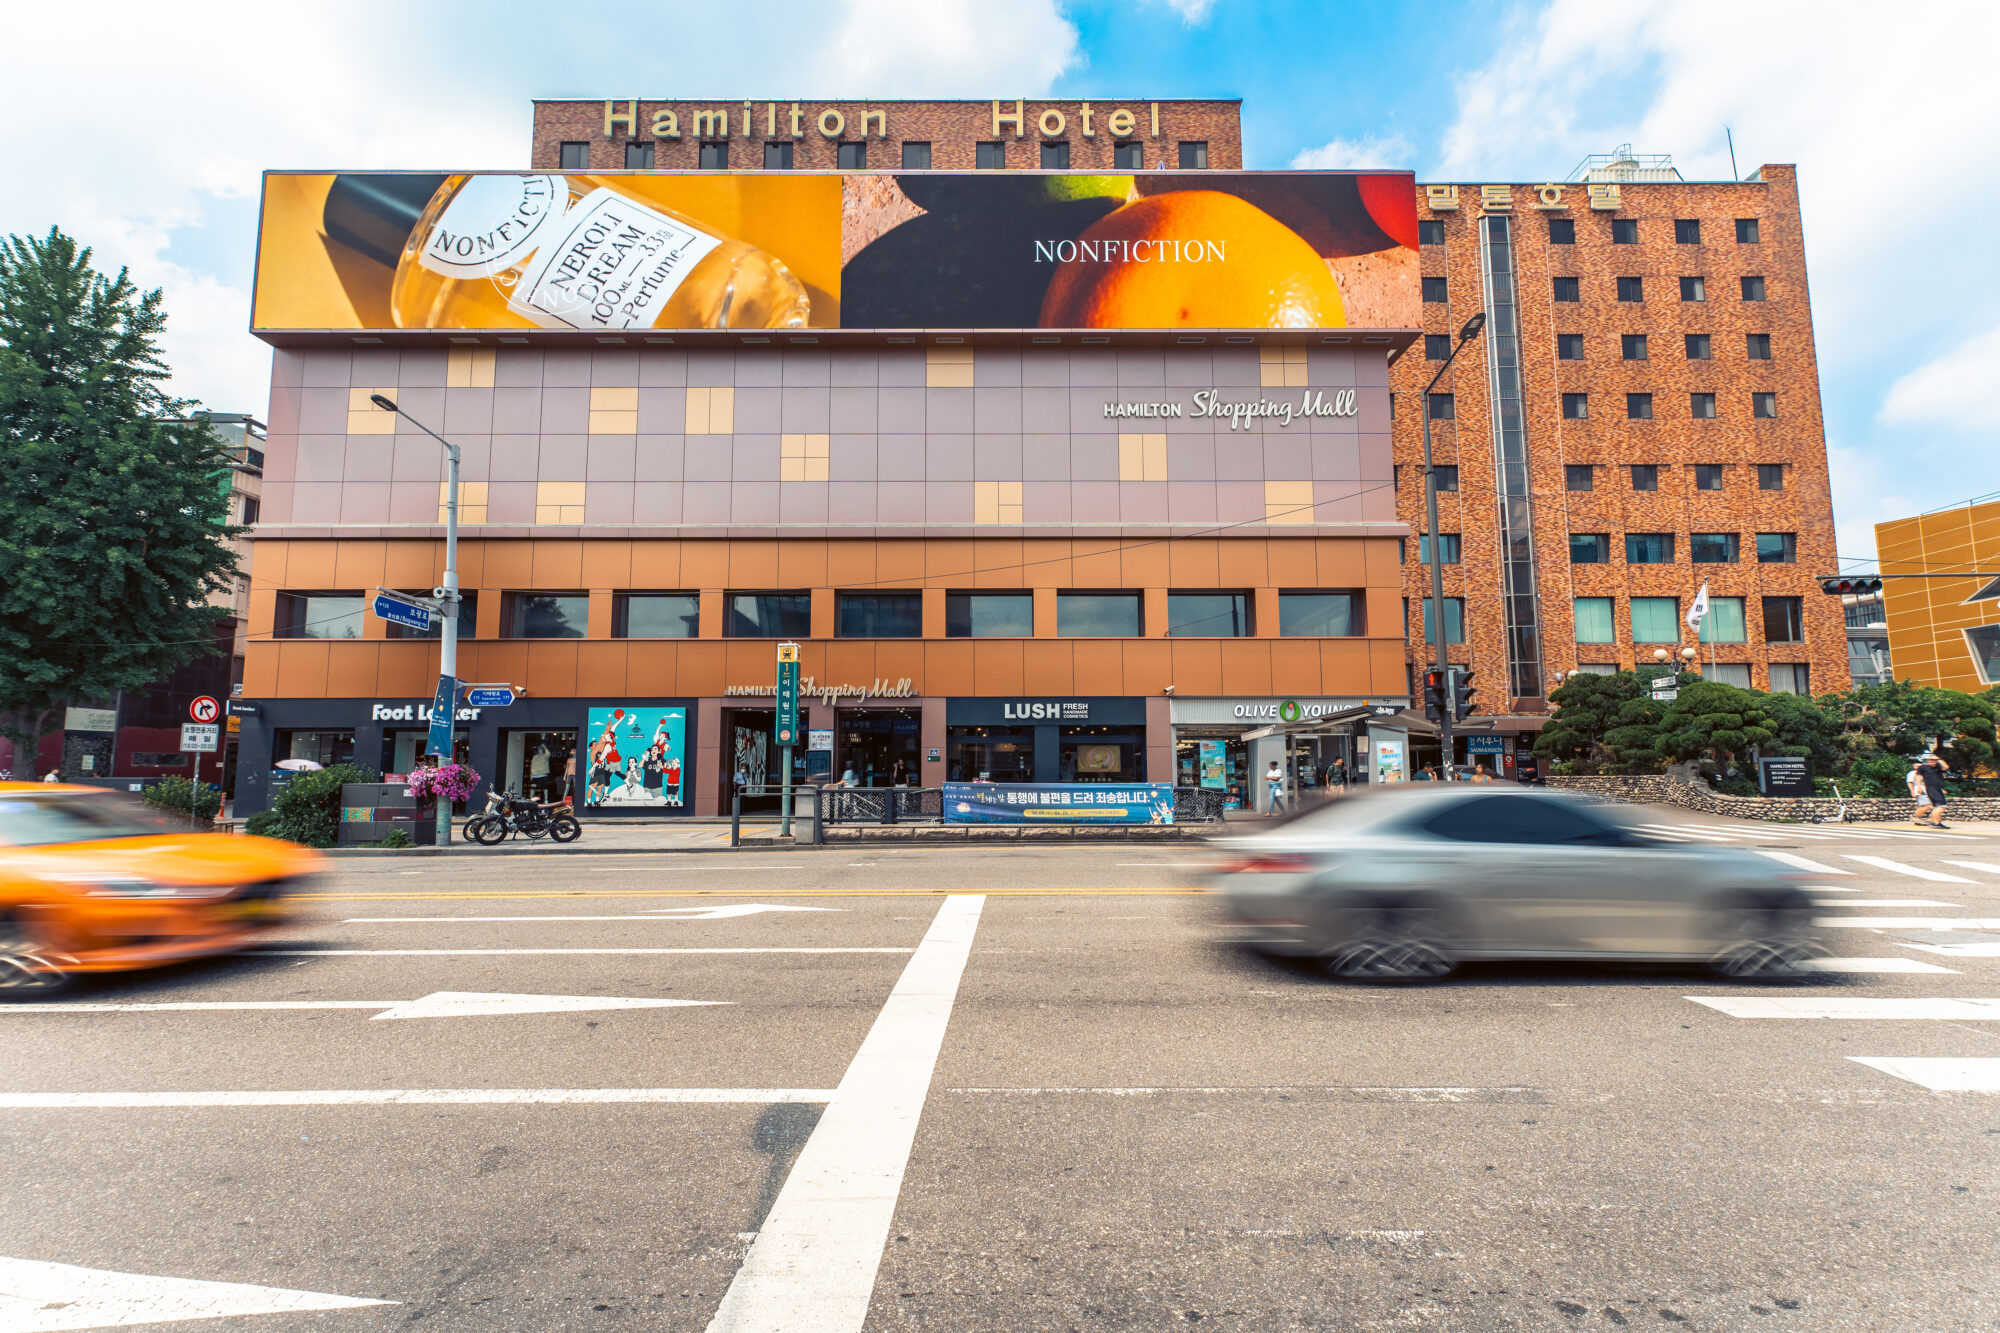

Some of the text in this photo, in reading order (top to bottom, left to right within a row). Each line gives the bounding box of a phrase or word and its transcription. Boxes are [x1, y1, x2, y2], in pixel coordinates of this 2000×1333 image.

[603, 100, 1159, 138] Hamilton Hotel
[434, 175, 545, 256] NONFICTI
[550, 212, 623, 293] NEROLI
[1034, 239, 1227, 262] NONFICTION
[577, 225, 647, 304] DREAM
[621, 249, 684, 321] Perfume
[1104, 389, 1358, 430] HAMILTON Shopping Mall
[409, 608, 428, 620] 보광로
[727, 676, 913, 706] HAMILTO Shopping Mall
[372, 704, 413, 720] Foot
[1004, 703, 1060, 719] LUSH
[1234, 705, 1277, 717] OLIVE
[1476, 736, 1503, 746] 사우나
[1007, 792, 1038, 804] 통행에
[1040, 792, 1071, 804] 불편을
[1073, 792, 1094, 804] 드려
[1096, 791, 1151, 804] 죄송합니다.
